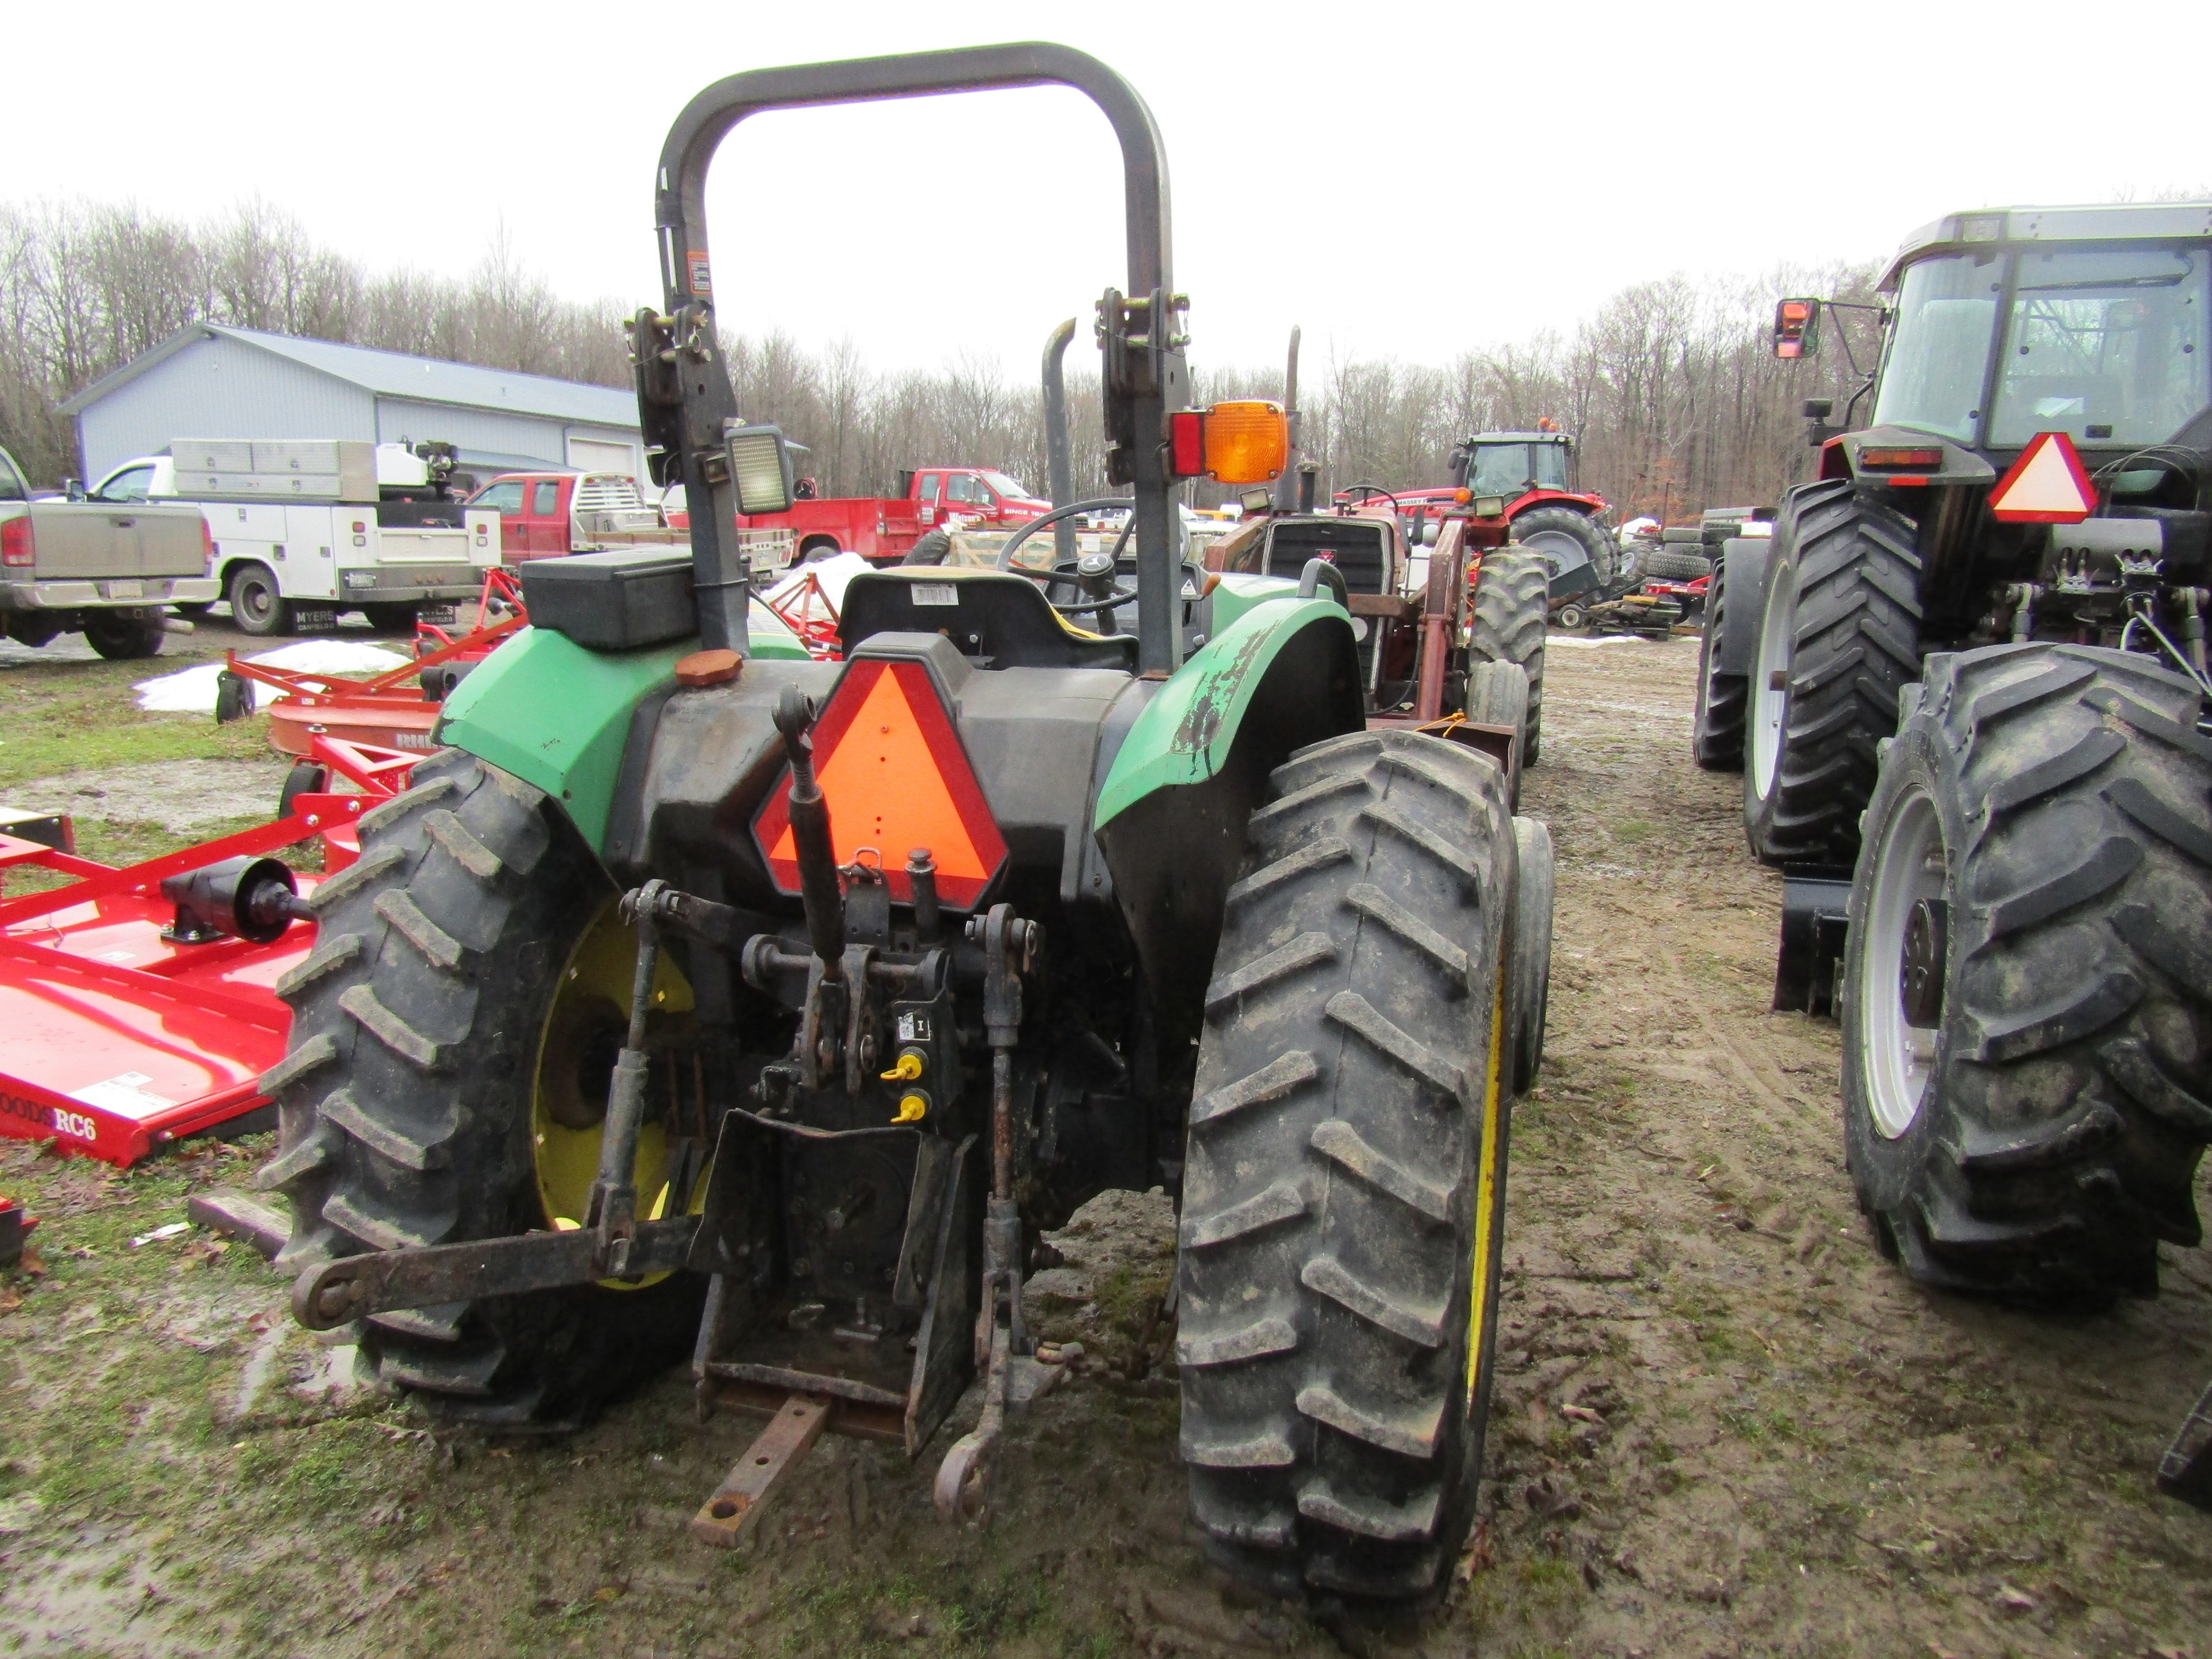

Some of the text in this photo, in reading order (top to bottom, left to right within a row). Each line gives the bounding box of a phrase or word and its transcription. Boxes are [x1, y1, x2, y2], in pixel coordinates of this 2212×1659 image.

[948, 512, 981, 523] Watson's
[296, 611, 334, 623] MYERS
[0, 1092, 57, 1129] OODS
[54, 1108, 97, 1141] RC6
